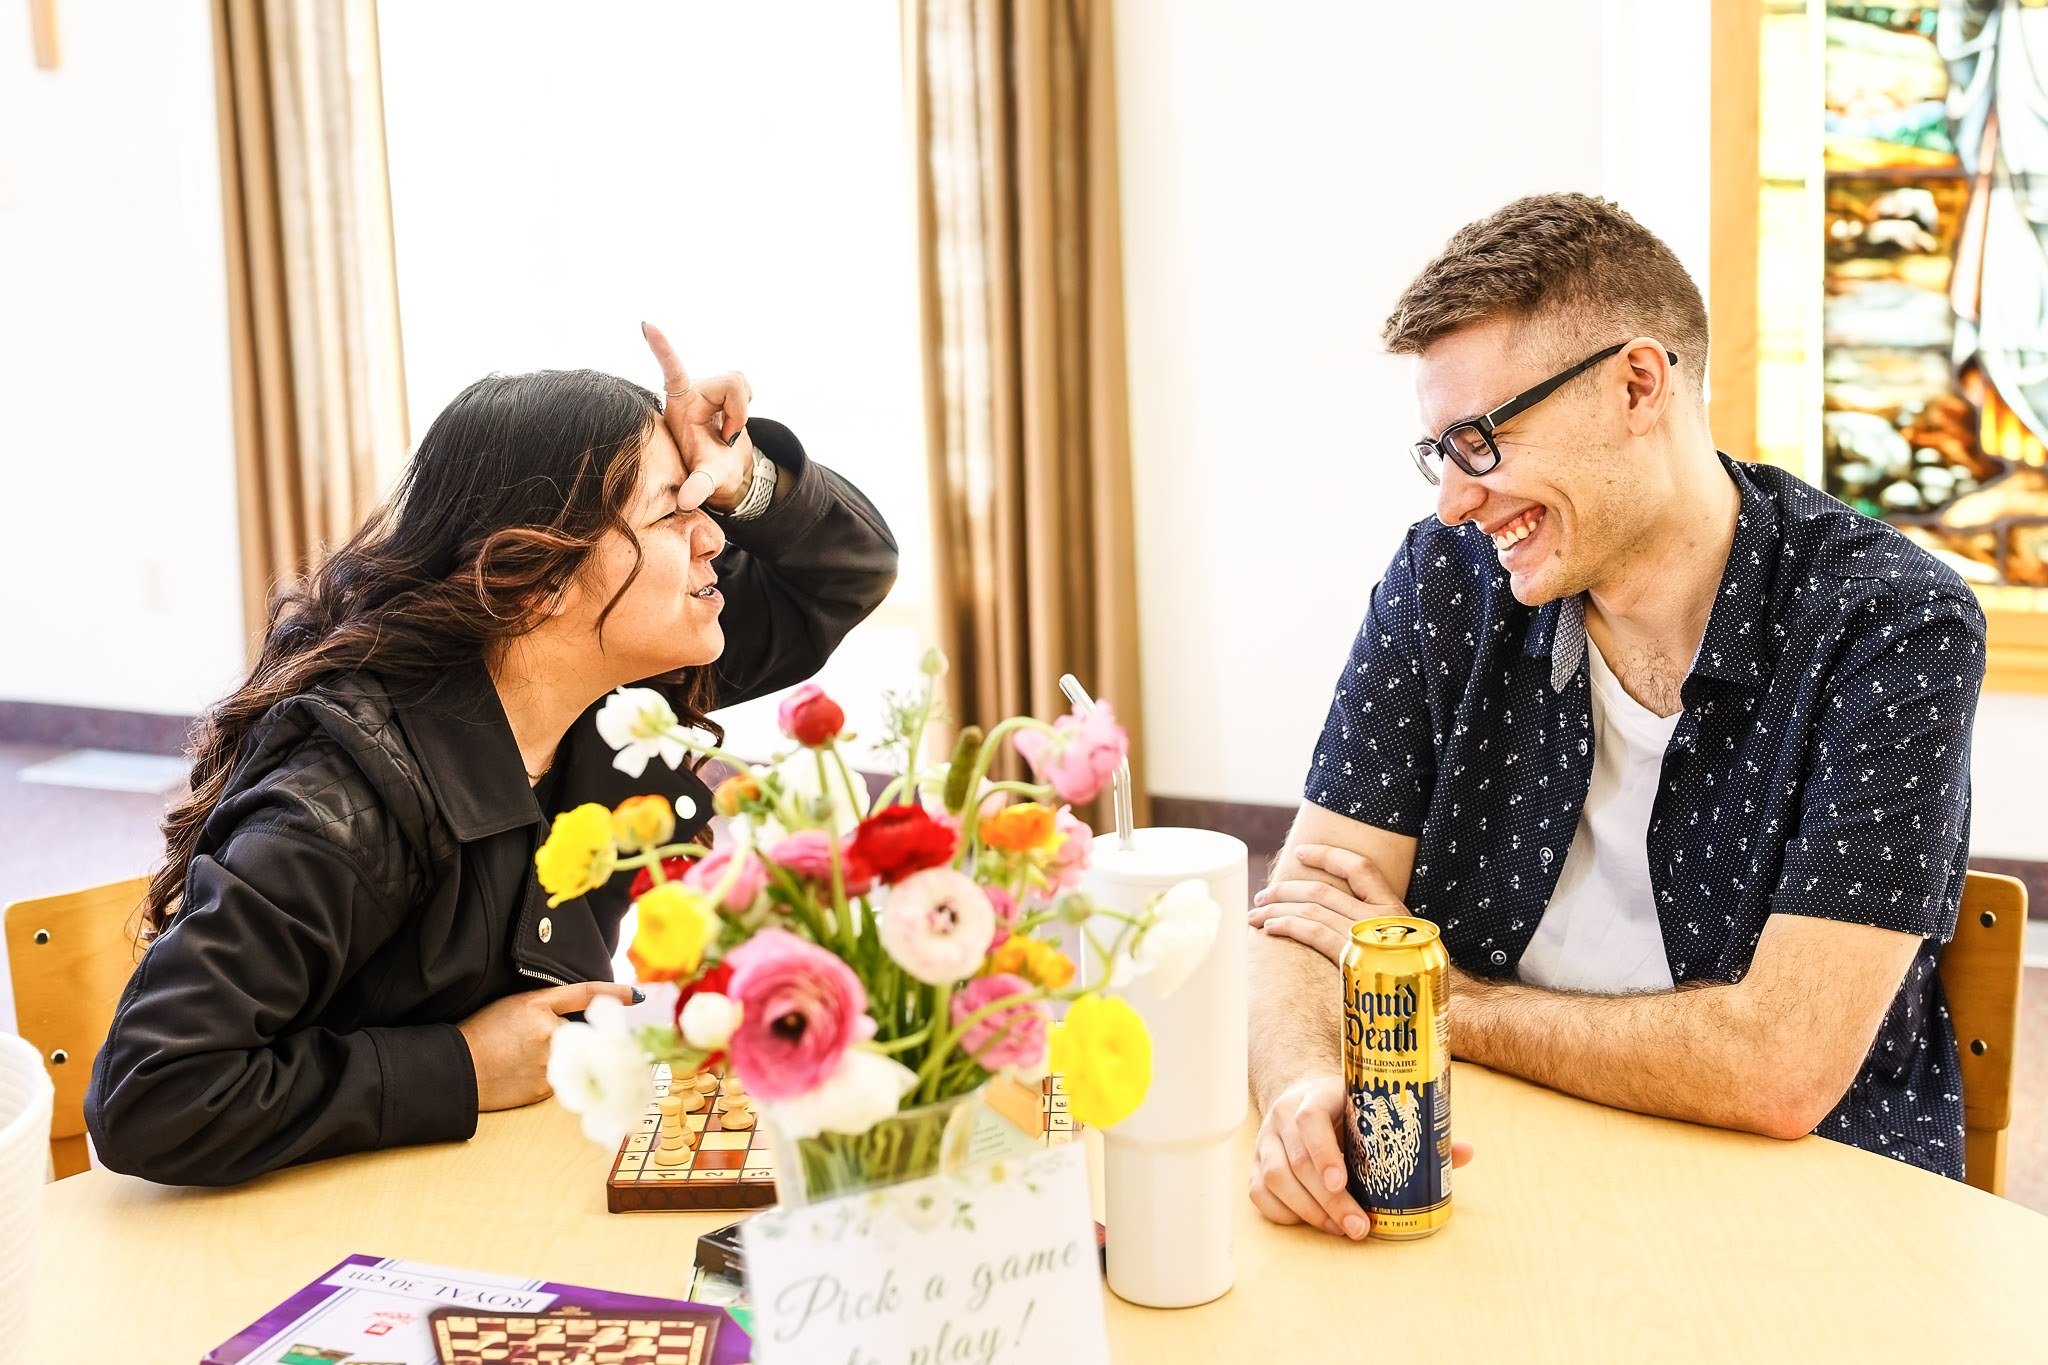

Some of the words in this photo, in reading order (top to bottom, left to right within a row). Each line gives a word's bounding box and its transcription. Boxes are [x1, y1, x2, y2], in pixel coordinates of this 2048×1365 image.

[1342, 972, 1417, 1025] Liquid
[1345, 1012, 1418, 1053] Death
[435, 1286, 533, 1309] ROYAL
[773, 1268, 901, 1344] Pick
[924, 1275, 946, 1302] a
[967, 1240, 1080, 1311] game
